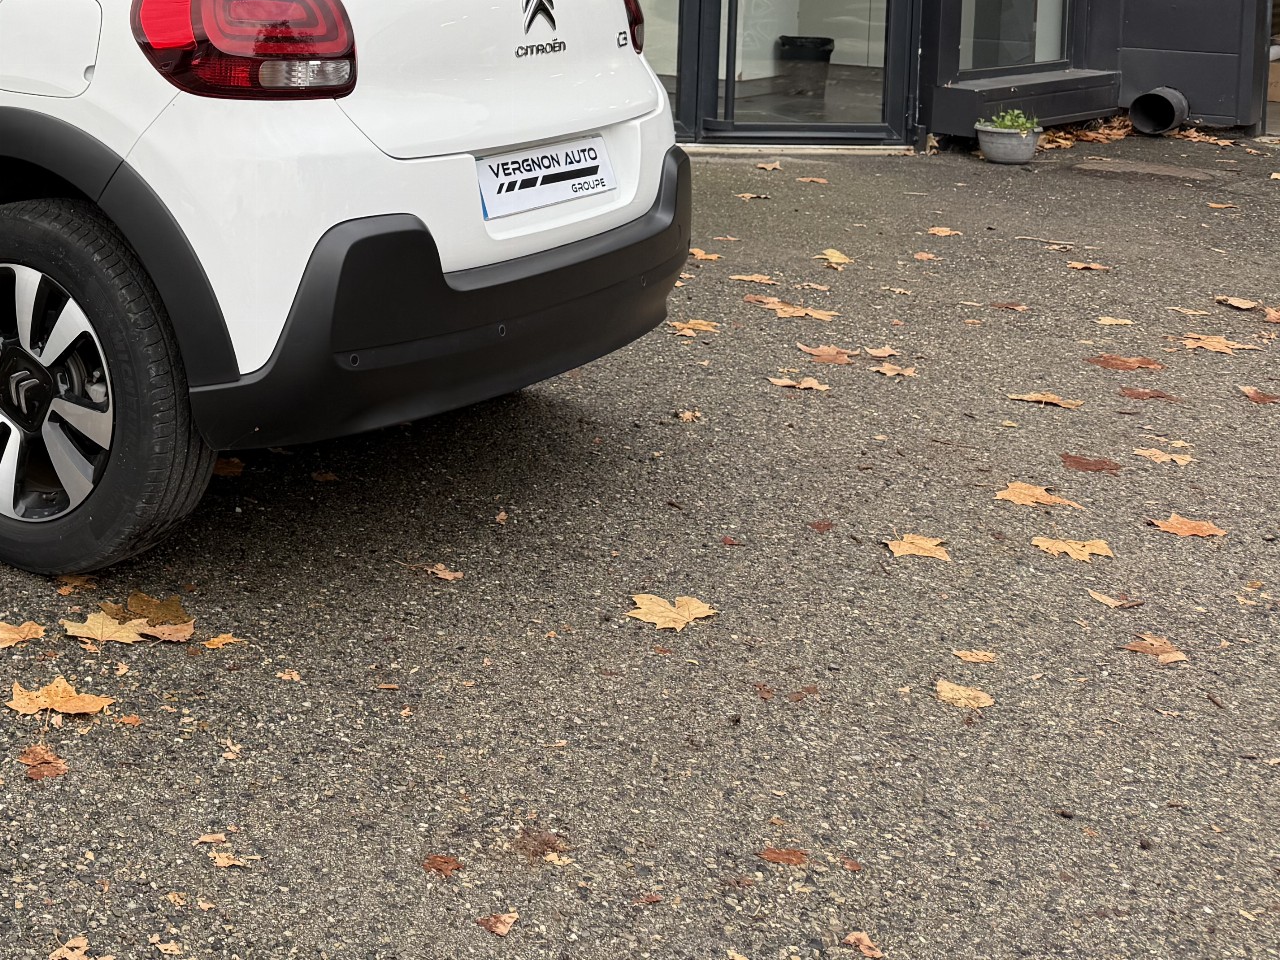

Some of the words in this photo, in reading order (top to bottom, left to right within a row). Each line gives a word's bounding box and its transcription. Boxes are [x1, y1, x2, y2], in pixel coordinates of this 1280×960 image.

[515, 38, 567, 58] CITROËN
[488, 152, 561, 178] VERGNON
[564, 147, 598, 166] AUTO
[571, 178, 606, 193] GROUPE
